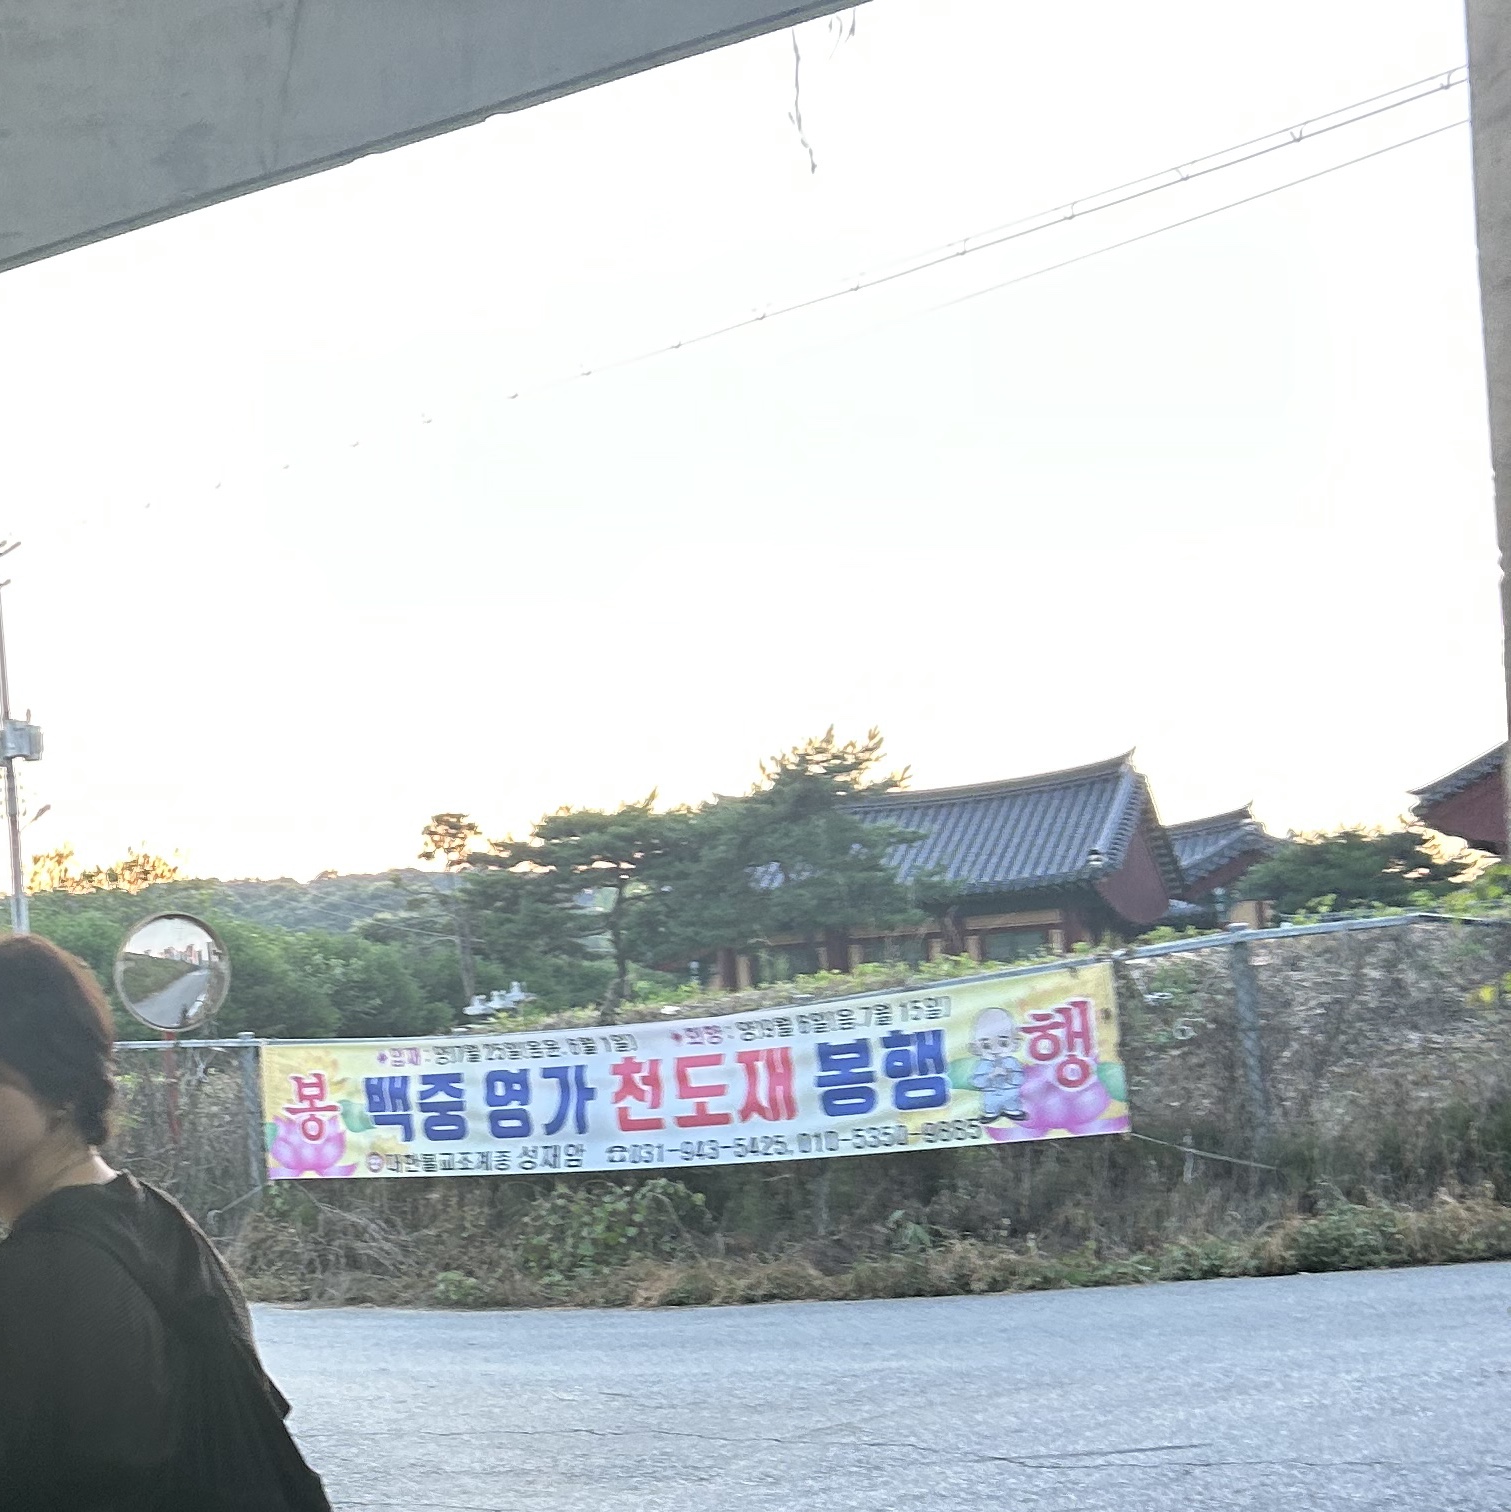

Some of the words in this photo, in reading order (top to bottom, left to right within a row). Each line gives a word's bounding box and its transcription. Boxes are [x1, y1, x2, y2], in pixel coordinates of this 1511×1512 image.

[610, 1045, 799, 1133] 천도재
[815, 1027, 950, 1118] 봉행
[1018, 999, 1093, 1088] 행
[284, 1072, 341, 1141] 봉
[385, 1149, 512, 1174] 대한불교조계종
[516, 1143, 587, 1171] 성재암
